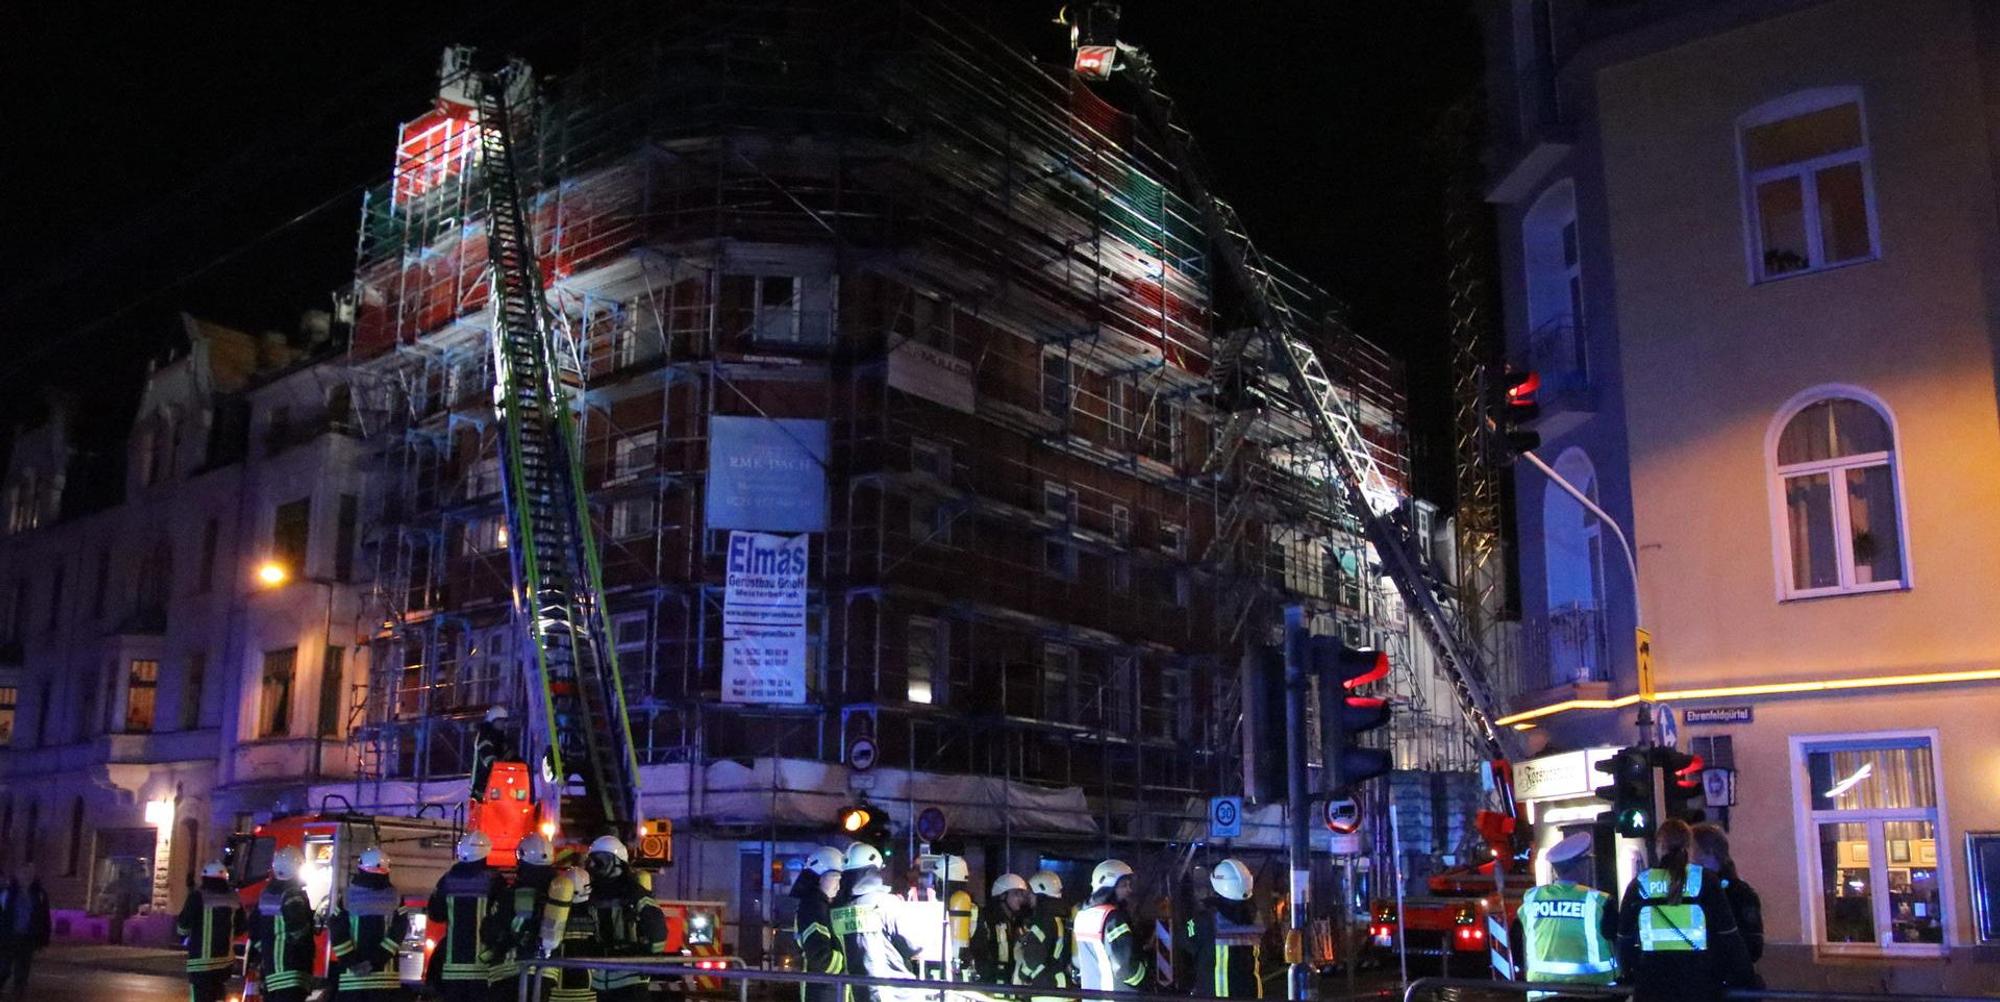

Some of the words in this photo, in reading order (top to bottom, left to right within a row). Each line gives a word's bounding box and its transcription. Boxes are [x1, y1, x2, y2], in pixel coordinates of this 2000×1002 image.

[730, 536, 804, 575] Elmas
[1687, 709, 1748, 722] Ehrenfeldgürtel
[1220, 807, 1232, 819] 30
